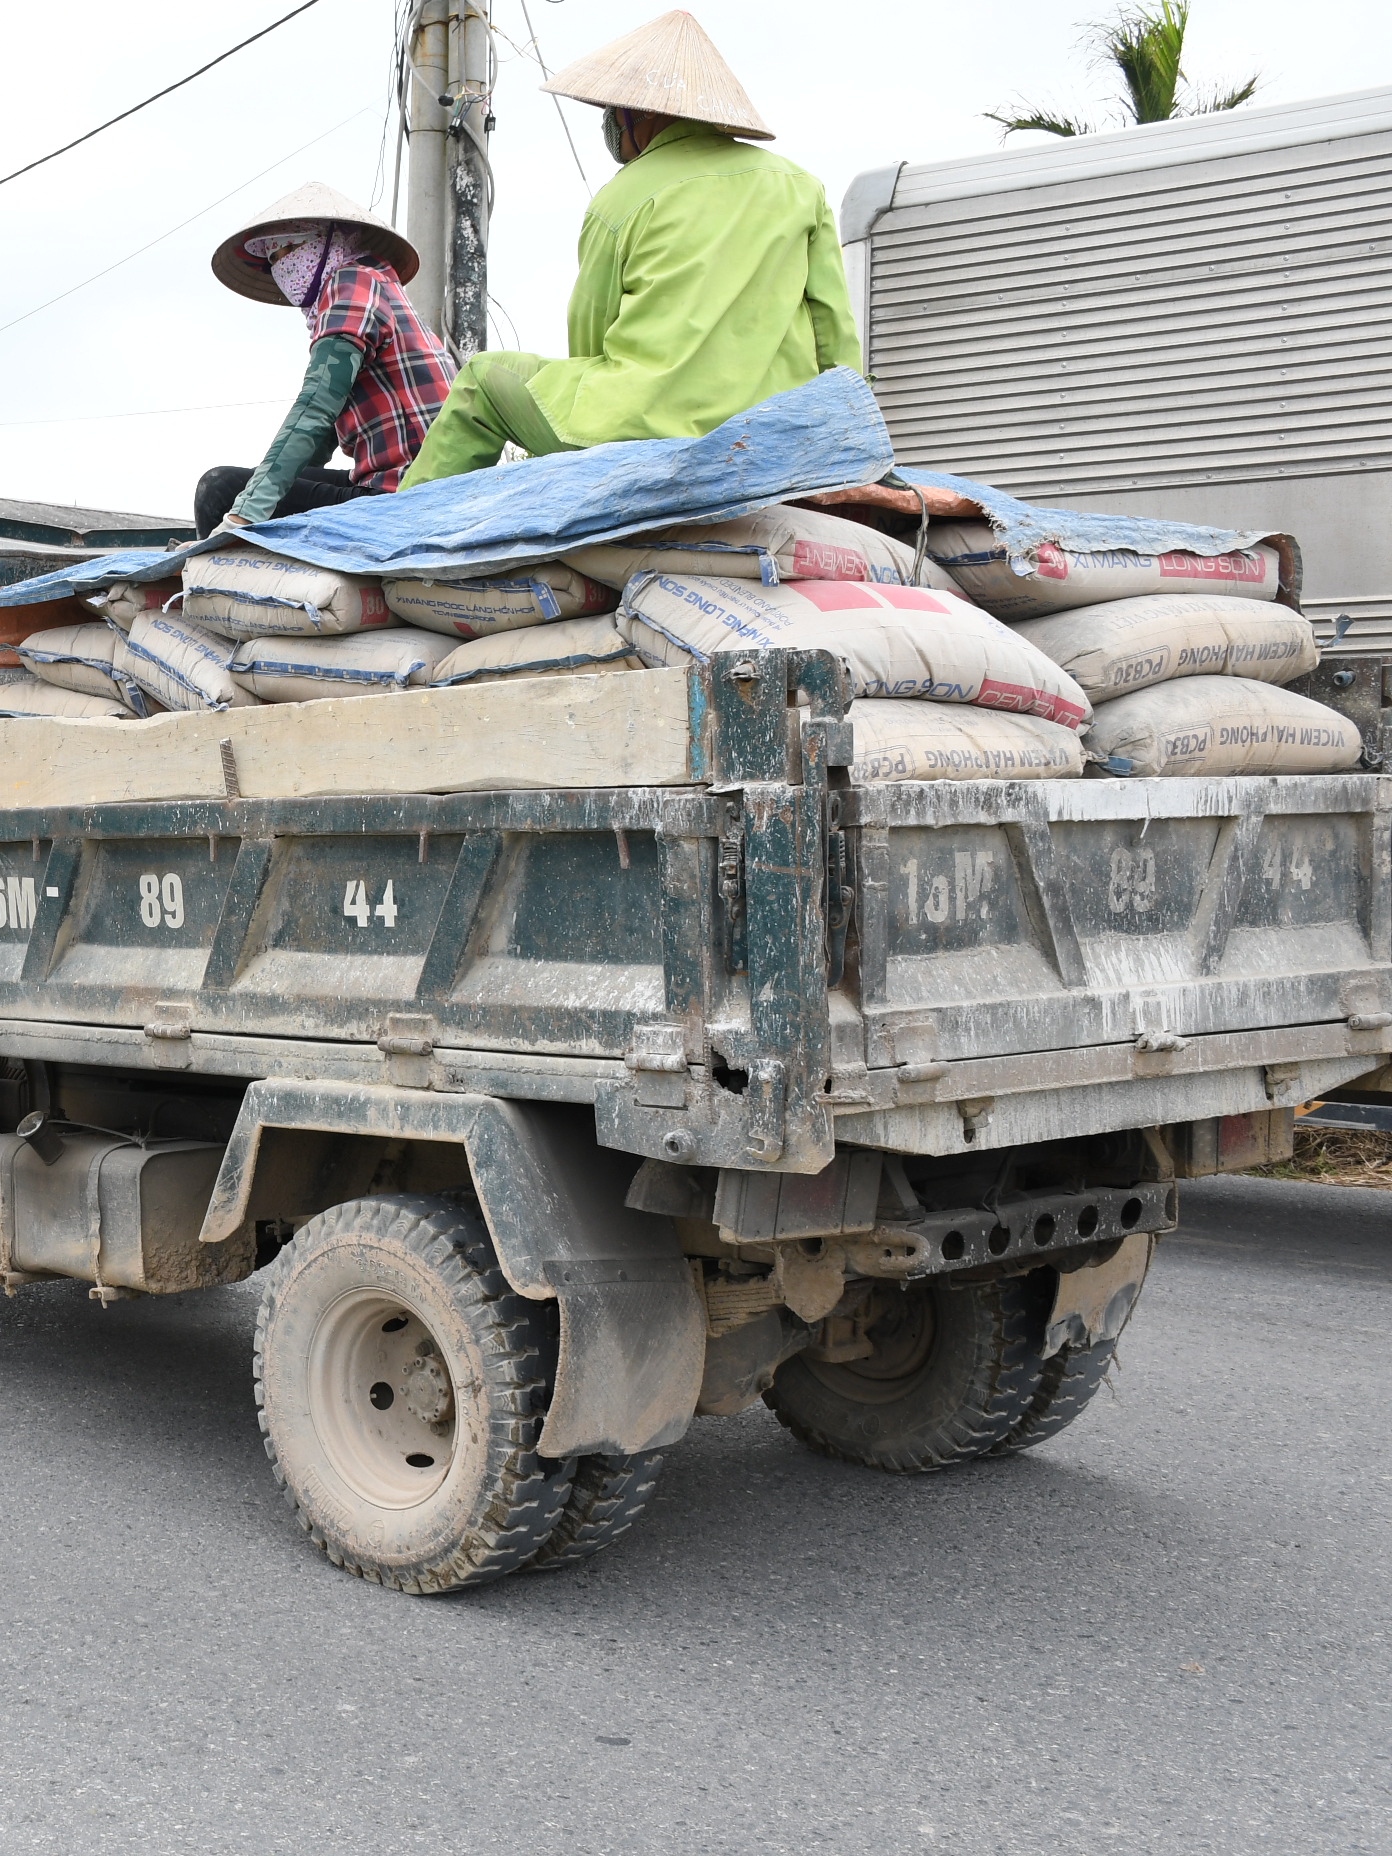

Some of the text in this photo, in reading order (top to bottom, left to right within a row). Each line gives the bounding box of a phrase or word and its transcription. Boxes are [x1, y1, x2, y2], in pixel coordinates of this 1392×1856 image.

[1161, 554, 1215, 572] LONG
[686, 593, 725, 620] LONG
[1113, 654, 1164, 687] PCB30
[978, 690, 1081, 729] CEMENT
[1300, 727, 1345, 748] VICEM
[1262, 840, 1311, 891] 44
[139, 873, 184, 929] 89
[343, 879, 398, 928] 44
